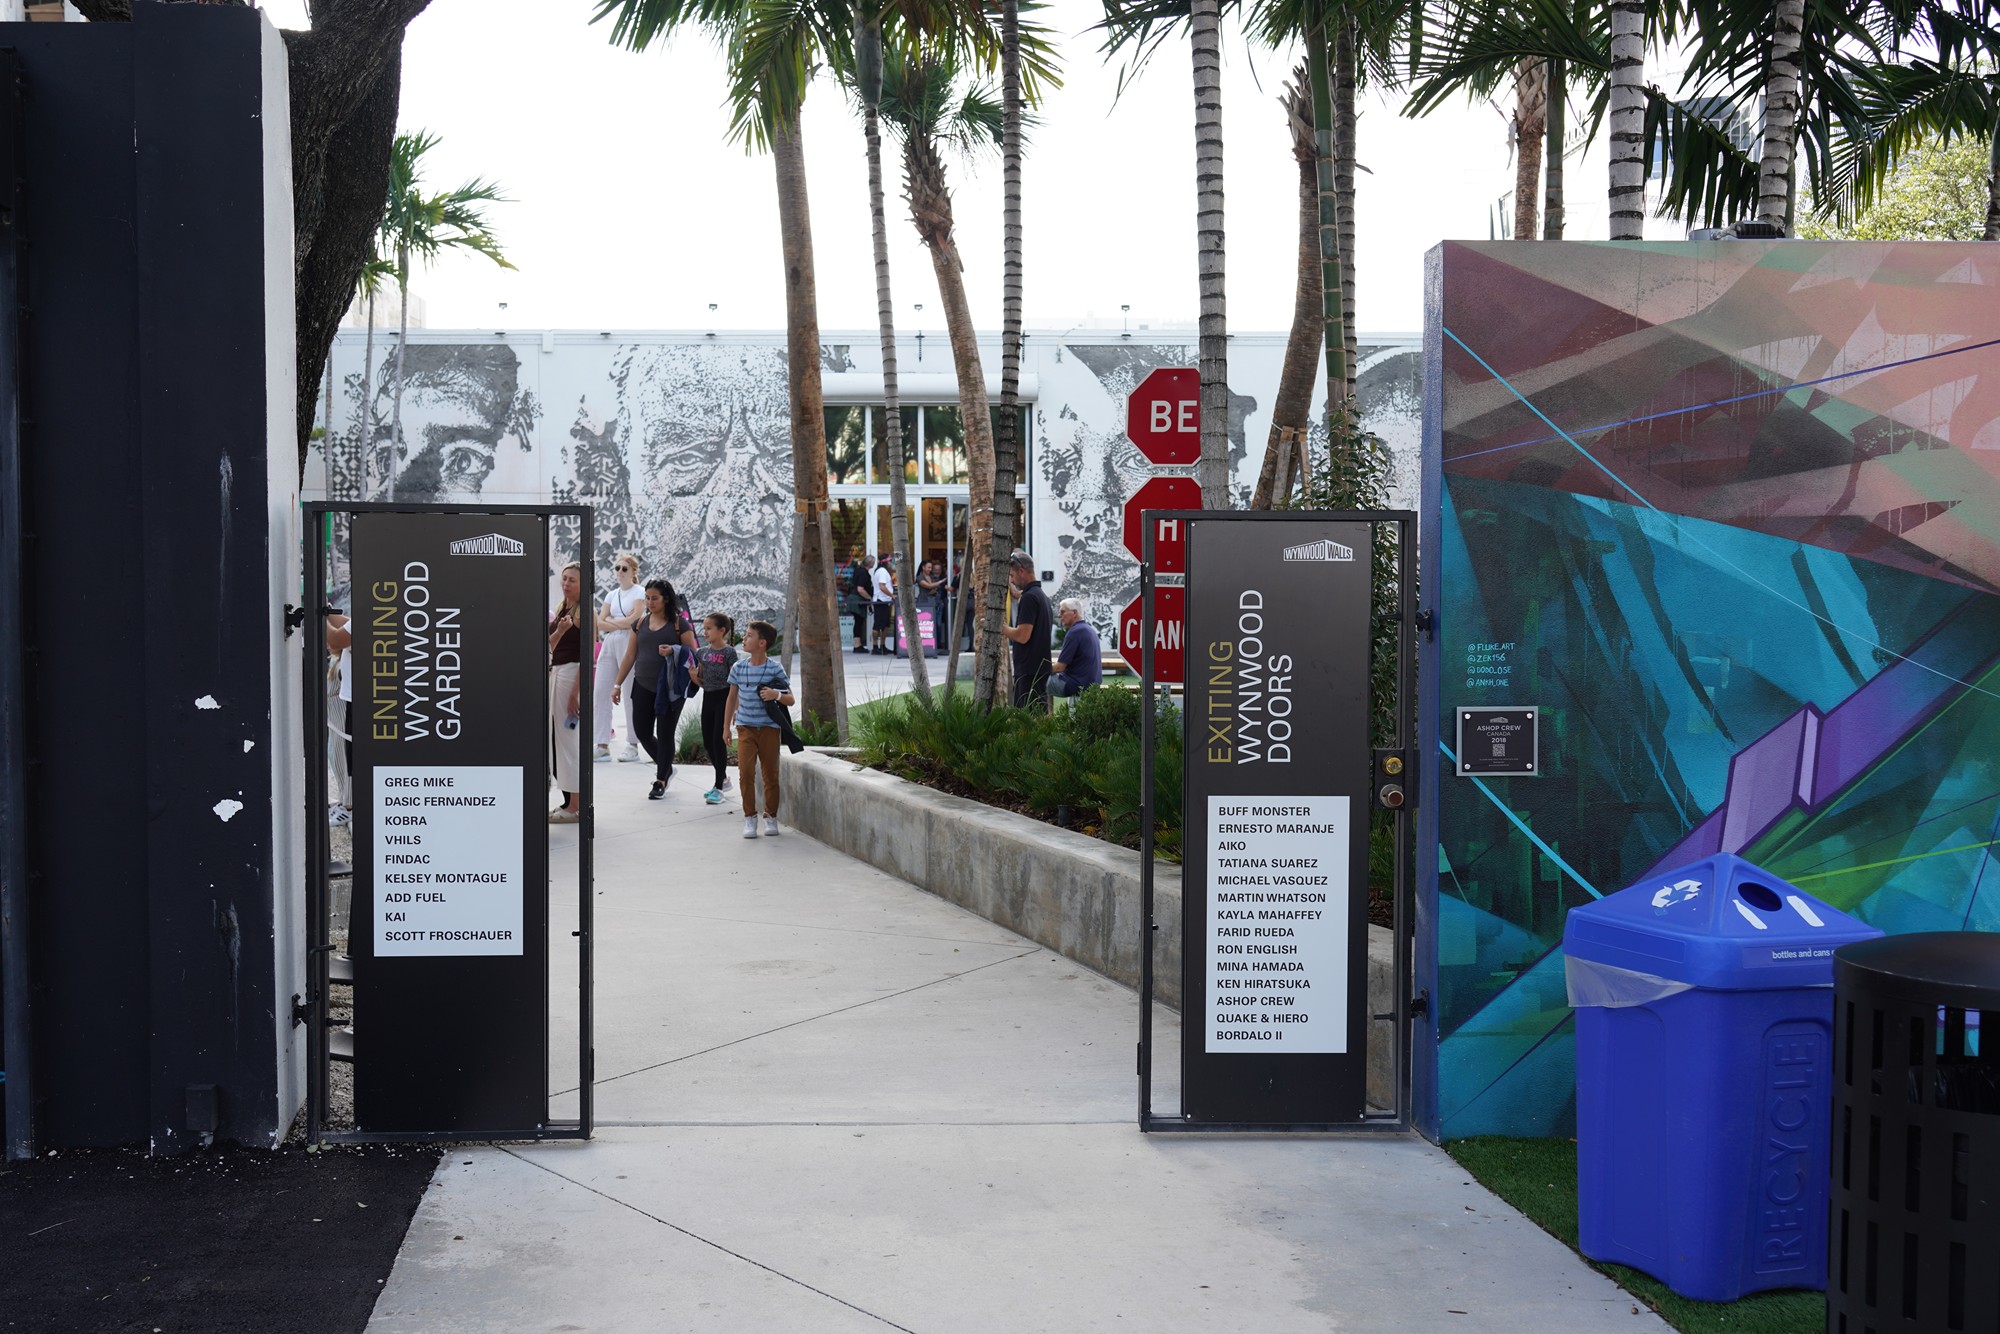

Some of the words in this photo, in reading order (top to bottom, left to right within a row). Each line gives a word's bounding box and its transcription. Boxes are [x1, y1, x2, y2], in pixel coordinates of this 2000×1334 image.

[1149, 400, 1198, 433] BE
[452, 536, 494, 554] WYNWOOD
[496, 536, 522, 554] WALLS
[1285, 542, 1325, 560] WYNWOOD
[1327, 542, 1352, 560] WALLS
[403, 561, 430, 742] WYNWOOD
[372, 581, 398, 740] ENTERING
[435, 607, 462, 740] GARDEN
[1237, 589, 1264, 765] WYNWOOD
[1208, 641, 1234, 763] EXITING
[1267, 654, 1293, 763] DOORS
[384, 777, 420, 788] GREG
[423, 777, 455, 788] MIKE
[384, 796, 421, 807] DASIC
[424, 796, 496, 807] FERNANDEZ
[1218, 806, 1249, 817] BUFF
[1251, 806, 1311, 817] MONSTER
[384, 815, 428, 826] KOBRA
[1218, 823, 1273, 834] ERNESTO
[1276, 823, 1335, 834] MARANJE
[384, 834, 422, 845] VHILS
[1217, 841, 1247, 851] AIKO
[385, 854, 431, 865] FINDAC
[1217, 858, 1268, 868] TATIANA
[1270, 858, 1318, 869] SUAREZ
[385, 873, 432, 884] KELSEY
[435, 873, 508, 884] MONTAGUE
[1217, 875, 1271, 886] MICHAEL
[1272, 875, 1328, 886] VASQUEZ
[384, 892, 412, 903] ADD
[415, 892, 447, 903] FUEL
[1217, 892, 1264, 903] MARTIN
[1266, 892, 1326, 903] WHATSON
[385, 912, 406, 922] KAI
[1217, 910, 1255, 920] KAYLA
[1258, 910, 1323, 920] MAHAFFEY
[384, 931, 426, 942] SCOTT
[429, 930, 512, 941] FROSCHAUER
[1217, 927, 1251, 937] FARID
[1254, 927, 1295, 938] RUEDA
[1217, 944, 1243, 955] RON
[1246, 944, 1298, 955] ENGLISH
[1772, 951, 1797, 960] bottles
[1798, 949, 1812, 958] and
[1813, 949, 1831, 957] cans
[1217, 961, 1249, 972] MINA
[1252, 961, 1305, 972] HAMADA
[1216, 979, 1241, 989] KEN
[1244, 979, 1311, 989] HIRATSUKA
[1216, 996, 1258, 1006] ASHOP
[1260, 996, 1295, 1006] CREW
[1216, 1013, 1258, 1024] QUAKE
[1260, 1013, 1270, 1024] &
[1273, 1013, 1309, 1024] HIERO
[1216, 1030, 1273, 1041] BORDALO
[1275, 1030, 1283, 1041] II
[1762, 1042, 1817, 1265] RECYCLE
